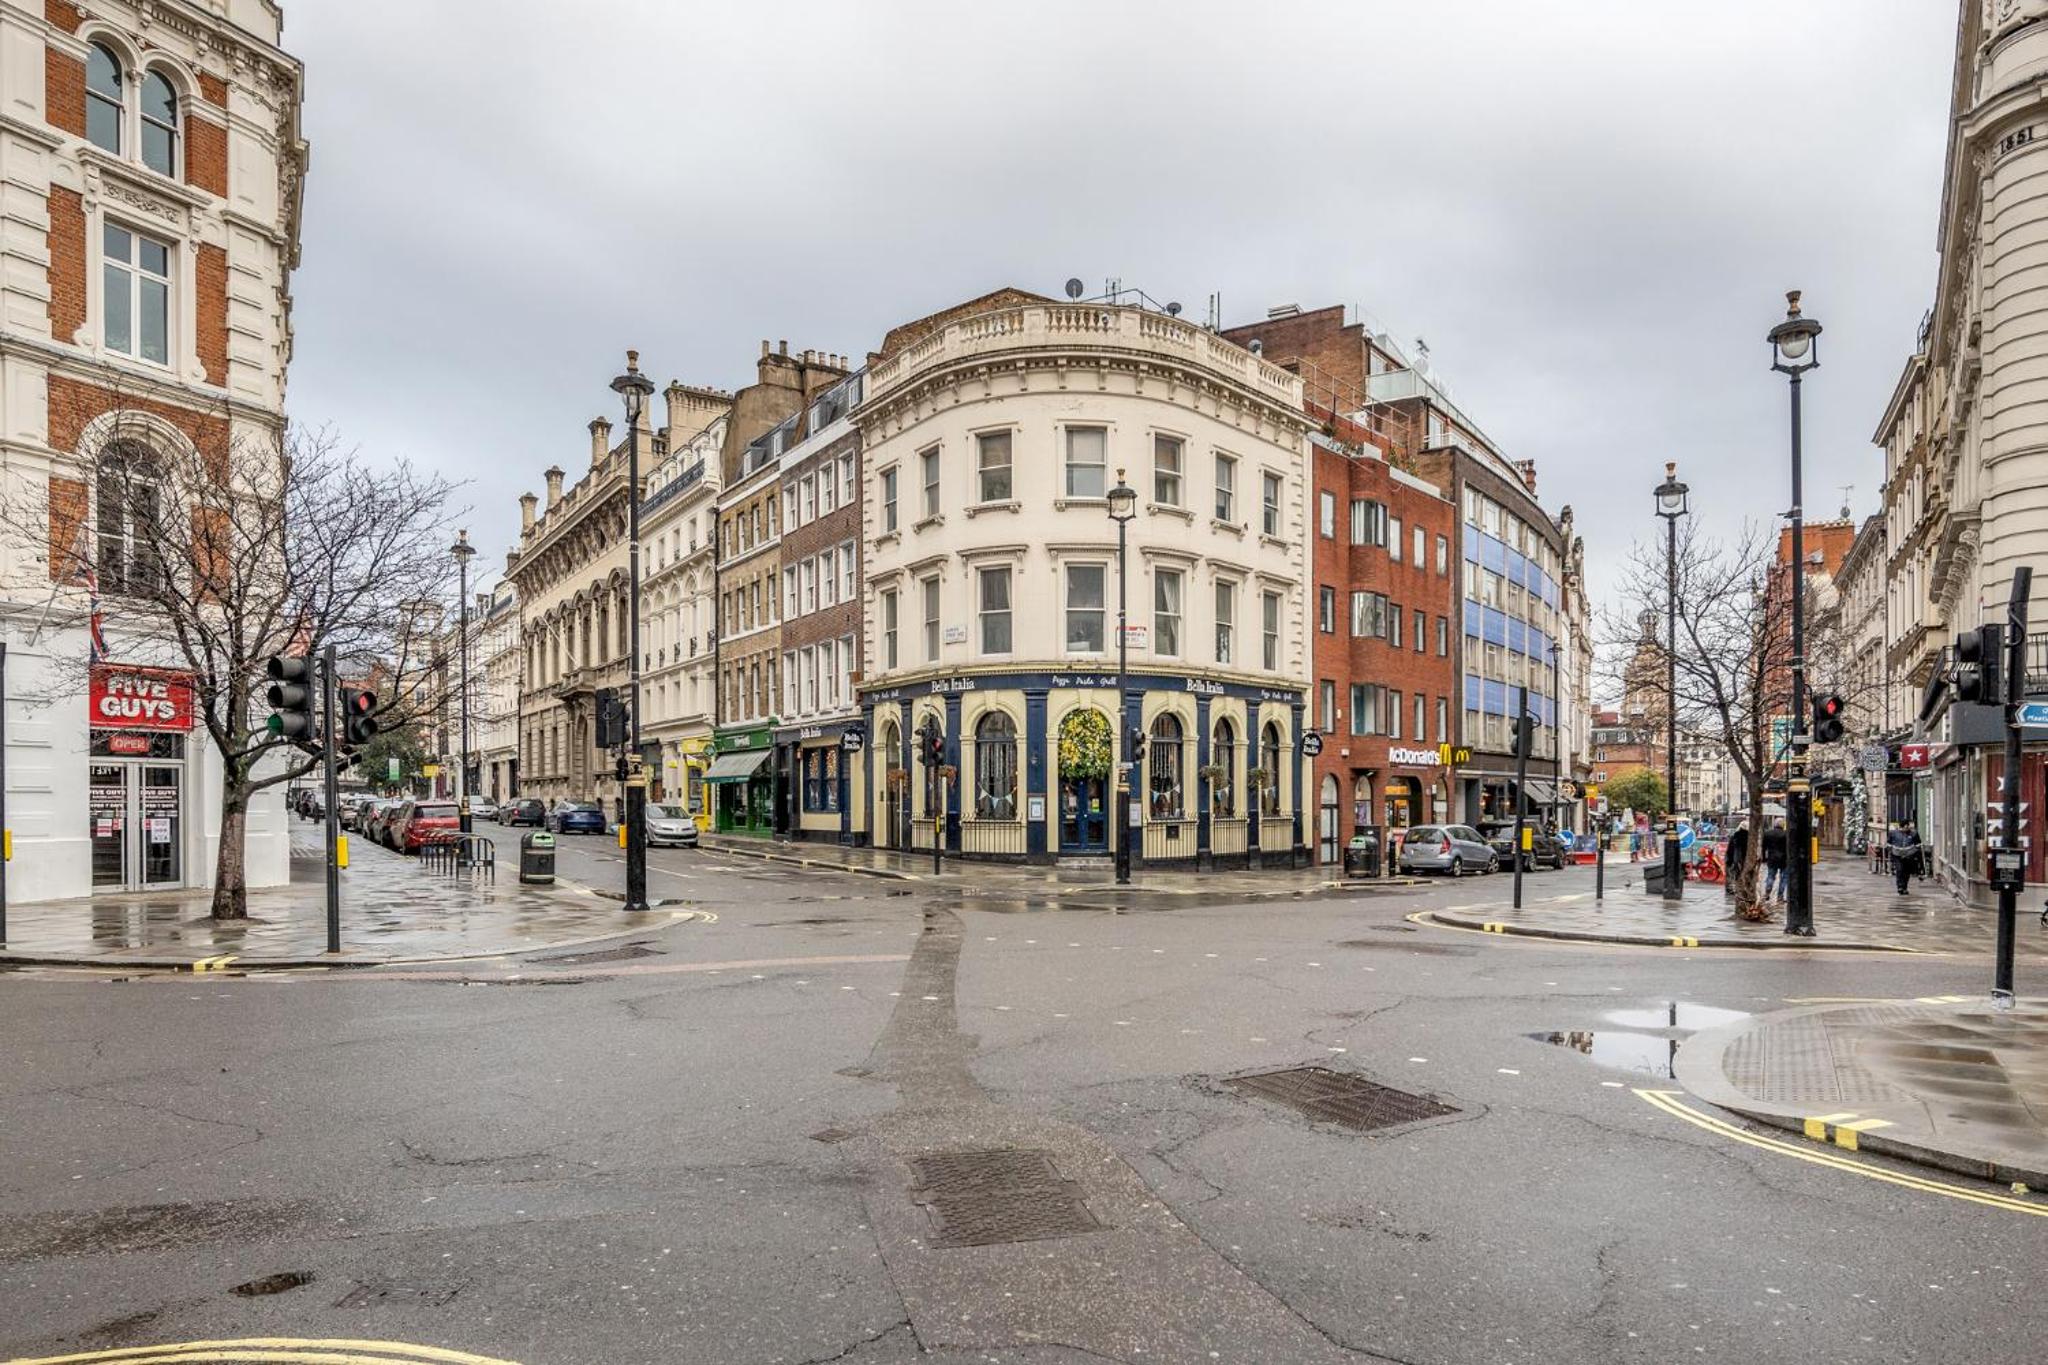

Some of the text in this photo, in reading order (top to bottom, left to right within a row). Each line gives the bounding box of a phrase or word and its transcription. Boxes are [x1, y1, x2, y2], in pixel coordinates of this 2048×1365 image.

[1999, 126, 2034, 154] 1851
[107, 676, 168, 698] FIVE
[932, 677, 976, 693] Bella Italia
[1186, 679, 1225, 694] Bella Italia
[100, 696, 176, 720] GUYS
